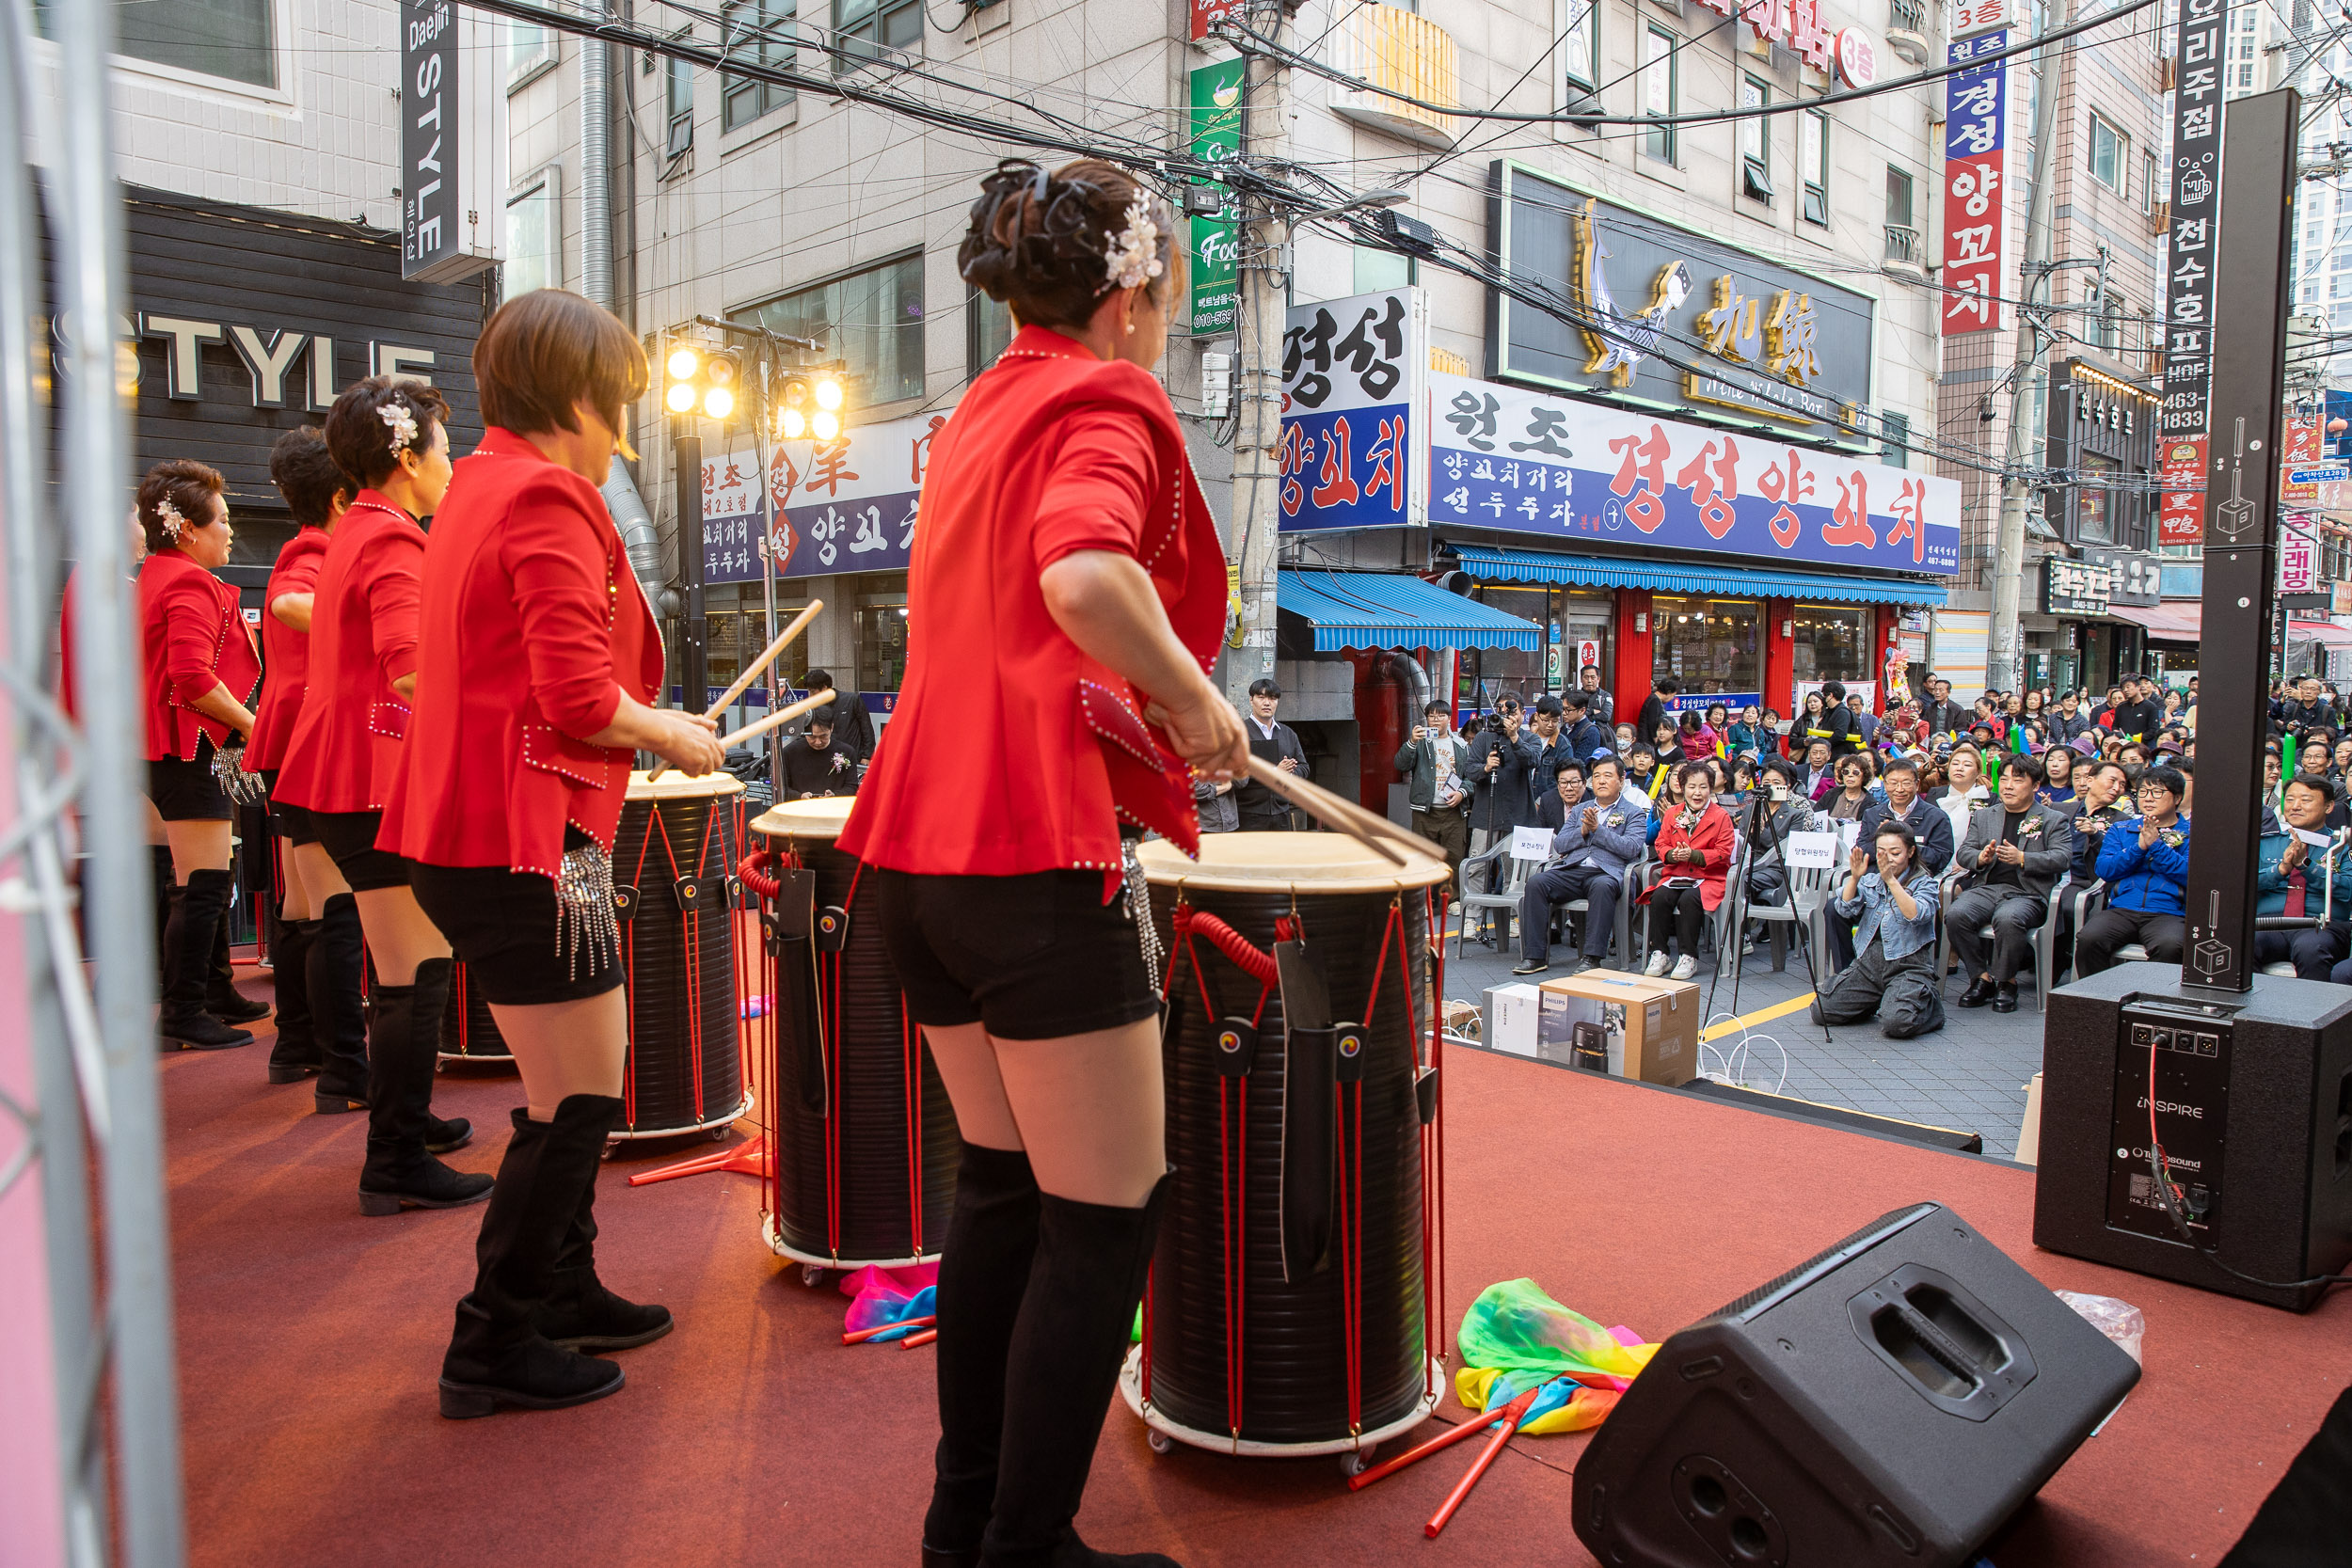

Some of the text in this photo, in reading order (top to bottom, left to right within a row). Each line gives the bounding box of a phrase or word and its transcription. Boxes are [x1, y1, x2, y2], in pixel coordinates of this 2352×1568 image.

[409, 1, 450, 54] Daejin
[1950, 36, 2005, 61] 원조
[1844, 34, 1873, 82] 3층
[417, 53, 442, 261] STYLE
[2170, 217, 2209, 362] 천수호프
[1280, 295, 1406, 409] 경성
[2168, 362, 2205, 383] HOF
[2080, 391, 2133, 436] 천수호프
[2162, 410, 2204, 430] 1833
[2163, 391, 2207, 410] 463-
[1444, 389, 1574, 460] 원조
[701, 463, 742, 496] 원조
[1279, 414, 1406, 517] 양꼬치
[1442, 451, 1574, 497] 양꼬치거리
[1442, 485, 1576, 527] 선두주자
[1607, 422, 1926, 564] 경성양꼬치
[2054, 564, 2110, 600] 천수호프
[1794, 847, 1830, 858] 당협위원장님
[1545, 997, 1565, 1006] PHILIPS
[1647, 1008, 1661, 1019] PHILIPS
